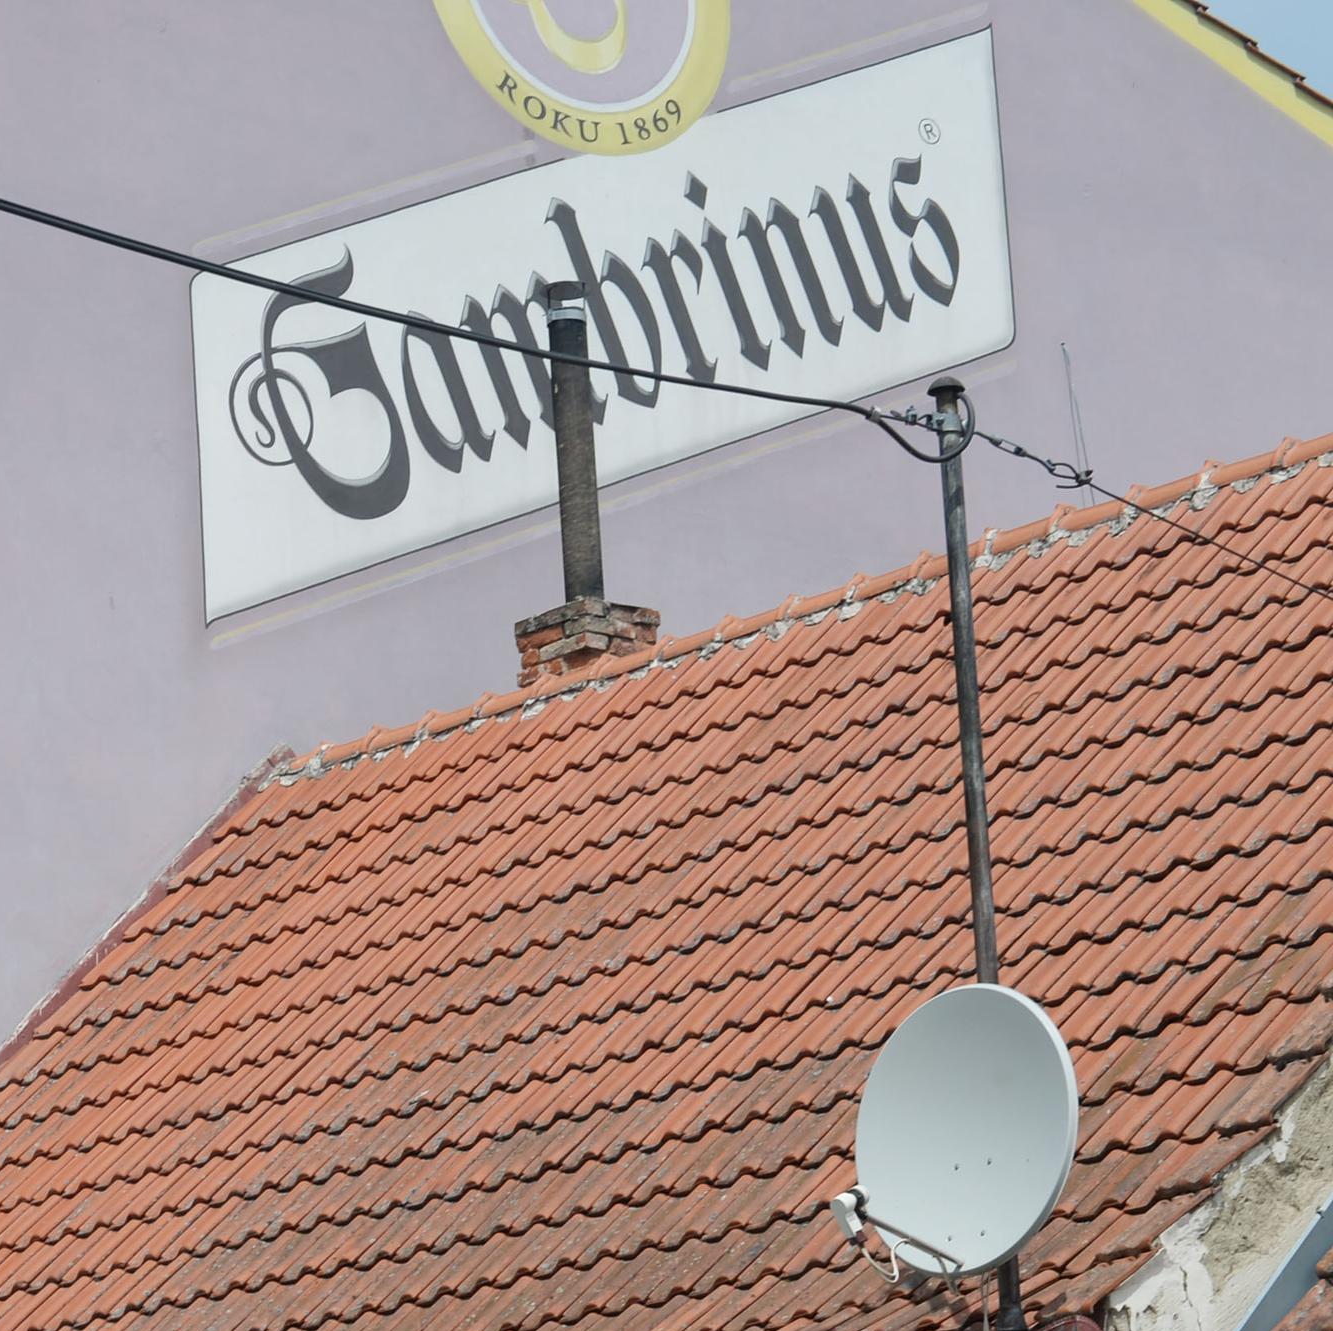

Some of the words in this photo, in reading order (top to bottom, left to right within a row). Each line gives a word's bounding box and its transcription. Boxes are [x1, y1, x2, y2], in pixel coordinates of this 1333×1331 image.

[495, 70, 601, 145] ROKU
[619, 98, 683, 146] 1869
[229, 152, 961, 521] Gambrinus
